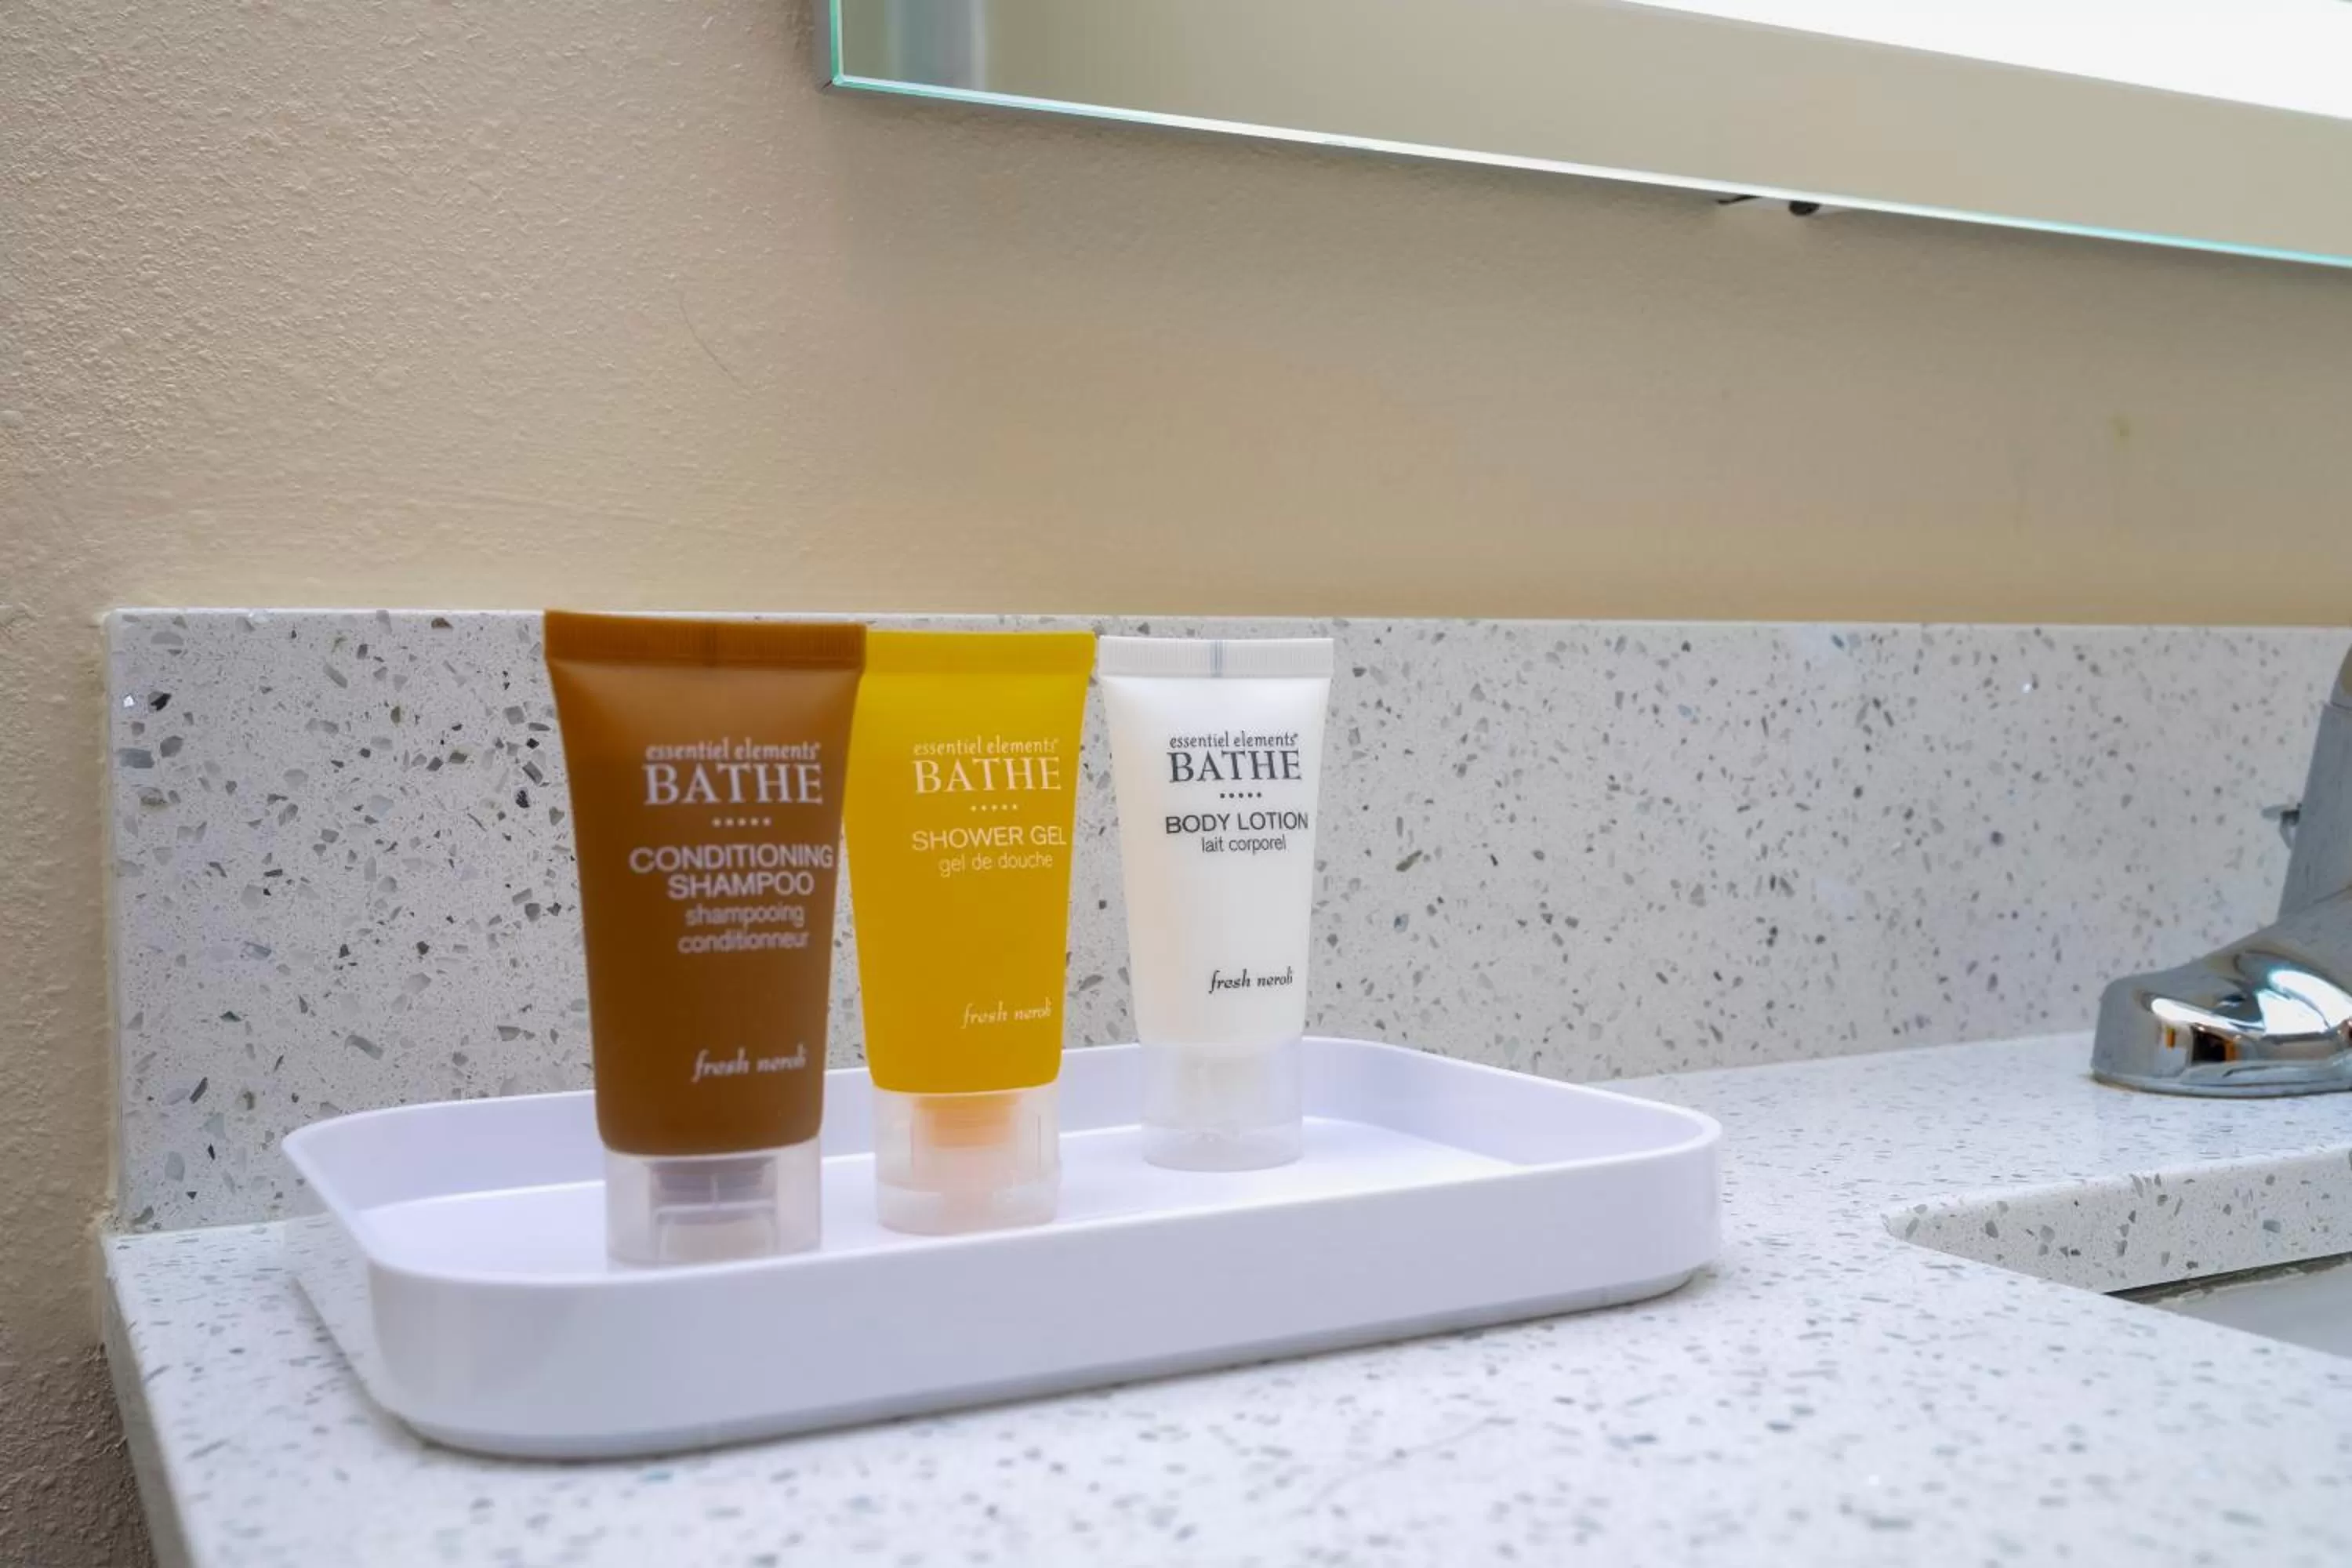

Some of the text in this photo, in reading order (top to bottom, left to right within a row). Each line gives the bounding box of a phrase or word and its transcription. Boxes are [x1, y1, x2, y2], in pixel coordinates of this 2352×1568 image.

[644, 737, 729, 760] essentiel
[913, 735, 982, 756] essentiel
[1169, 731, 1229, 749] essentiel
[912, 757, 1062, 794] BATHE
[1166, 750, 1302, 783] BATHE
[641, 761, 823, 805] BATHE
[1165, 811, 1308, 834] BODY LOTION
[911, 825, 1067, 851] SHOWER GEL
[1201, 834, 1287, 855] lait corporel
[628, 843, 834, 874] CONDITIONING
[939, 851, 1054, 878] gel de douche
[666, 870, 815, 900] SHAMPOO
[684, 903, 805, 931] shampooing
[1208, 965, 1293, 994] fresh neroli
[960, 1000, 1007, 1029] fresh
[691, 1047, 750, 1083] fresh
